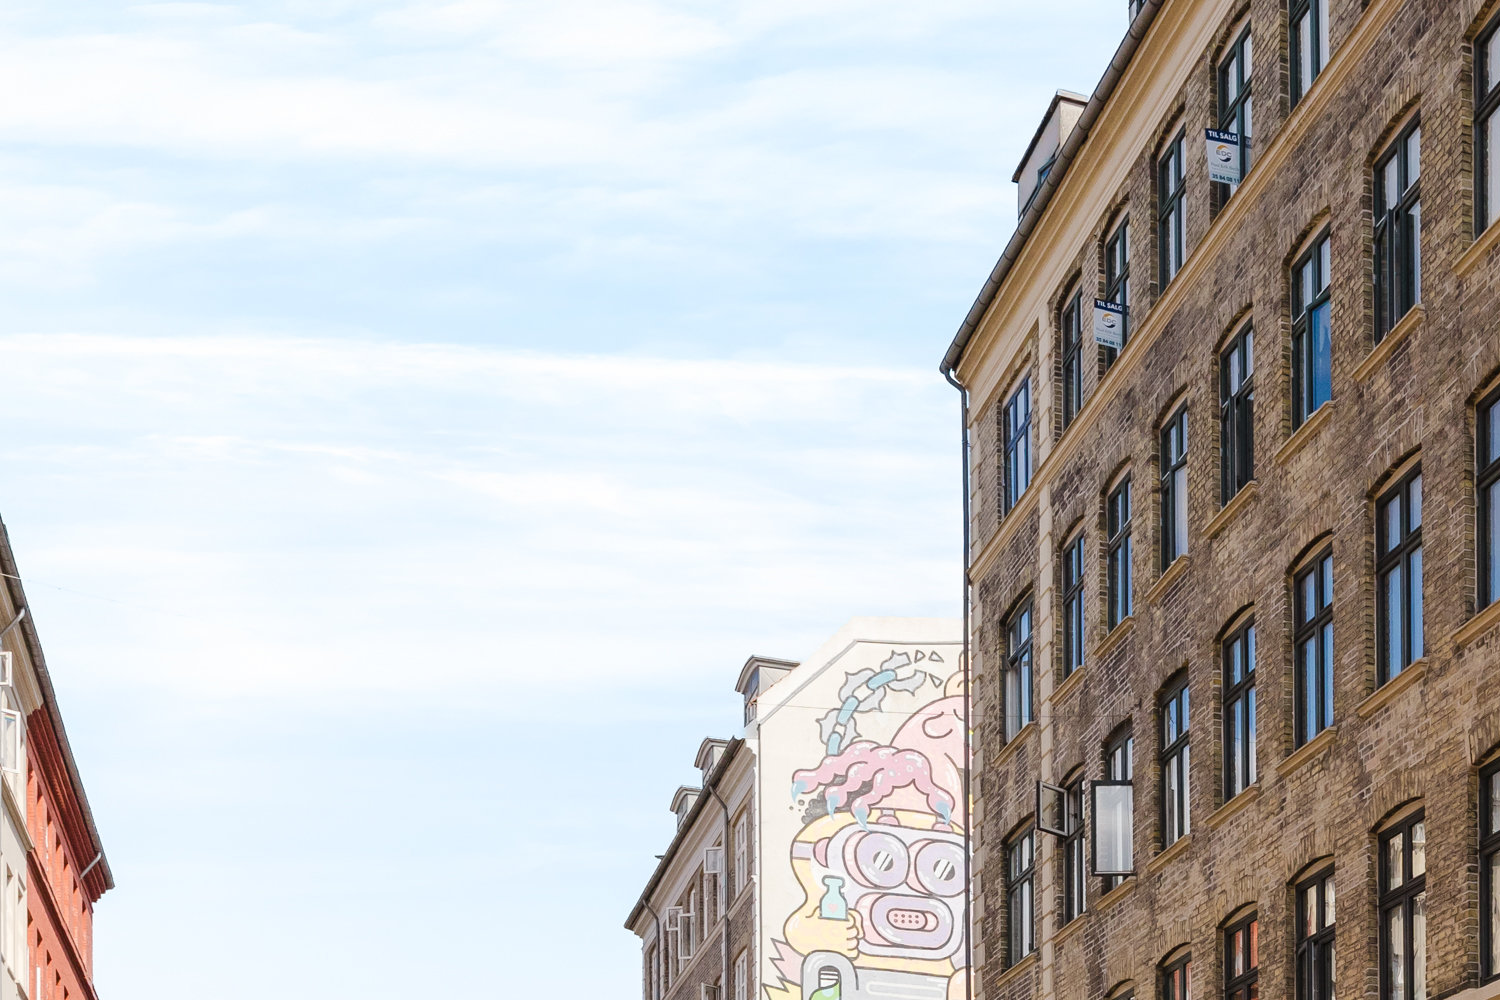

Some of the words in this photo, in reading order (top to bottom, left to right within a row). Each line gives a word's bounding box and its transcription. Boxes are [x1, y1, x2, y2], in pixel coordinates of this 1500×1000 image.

[1208, 130, 1219, 138] TIL
[1220, 133, 1237, 141] SALG
[1216, 150, 1232, 158] EDC
[1107, 303, 1122, 311] SALG
